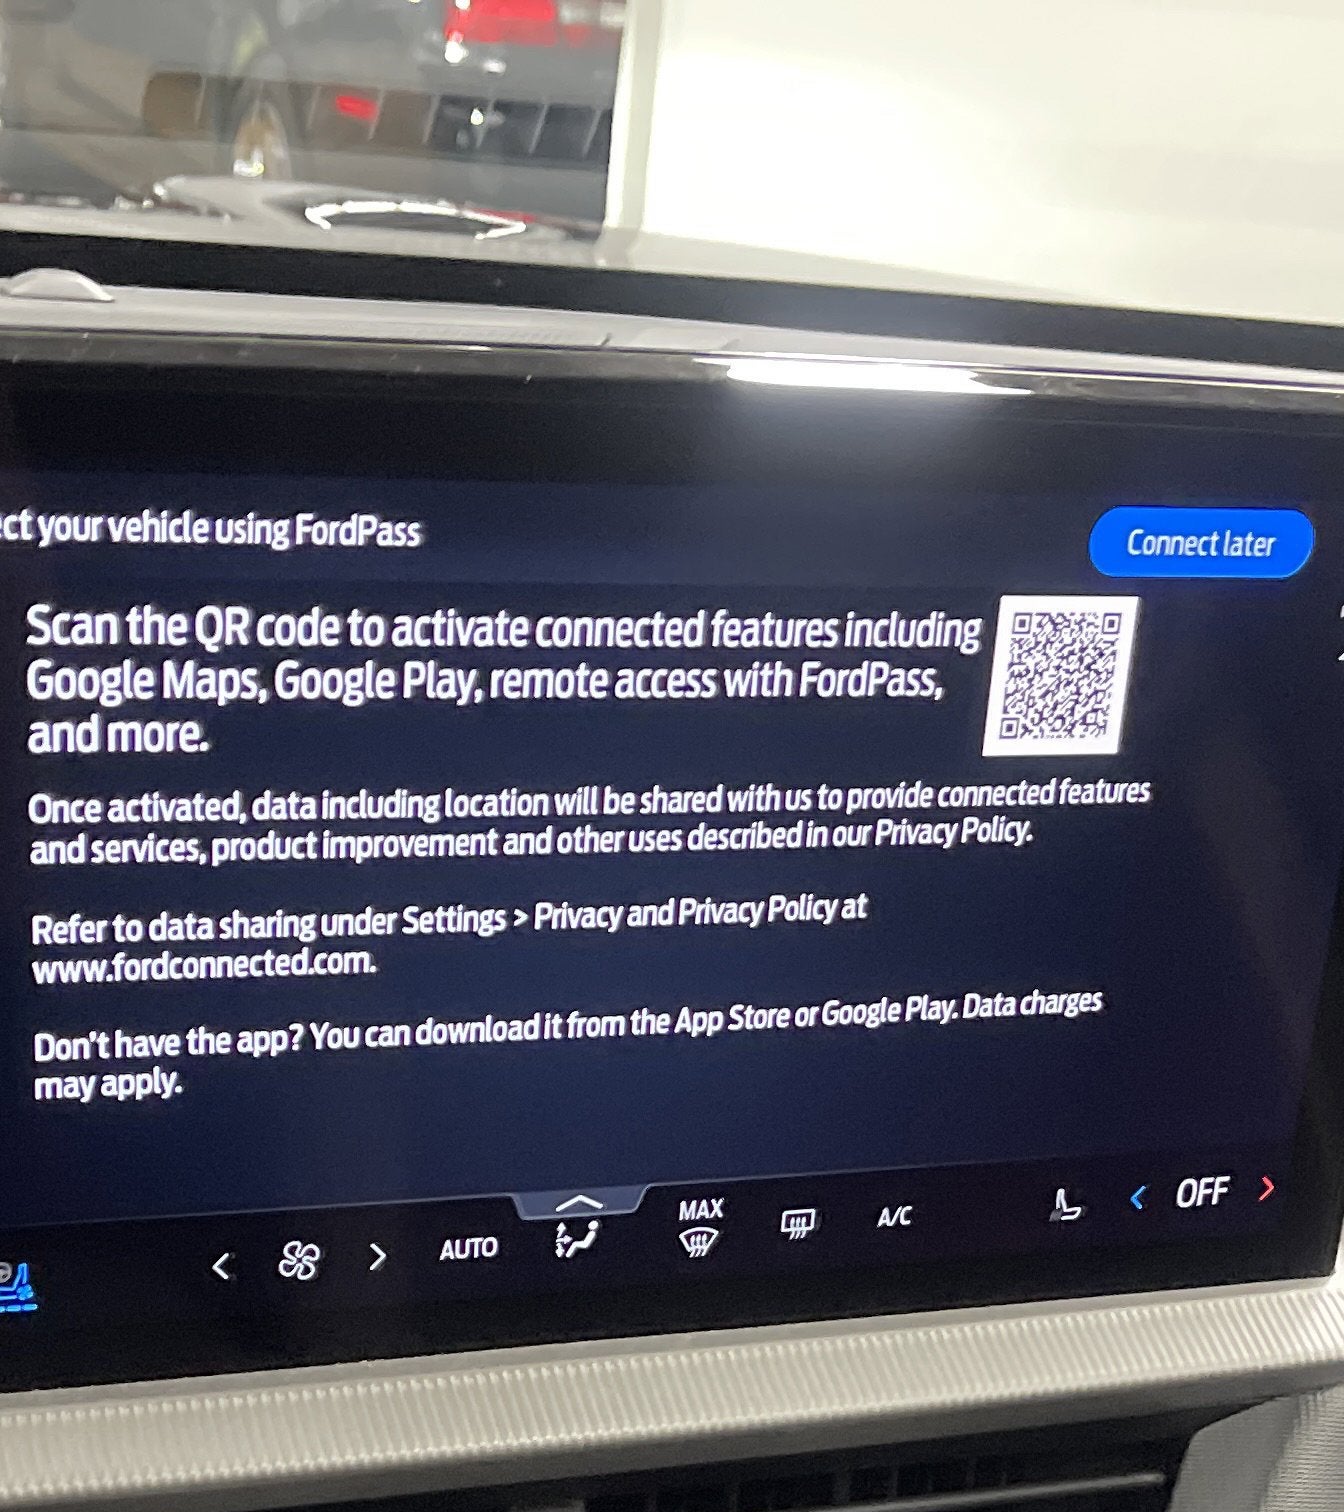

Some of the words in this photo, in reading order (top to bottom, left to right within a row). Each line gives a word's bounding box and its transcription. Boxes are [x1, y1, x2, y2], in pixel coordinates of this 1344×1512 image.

[36, 514, 104, 549] your
[107, 508, 212, 544] vehicle
[214, 511, 291, 552] using
[295, 512, 422, 548] FordPass
[1127, 529, 1221, 558] Connect
[1224, 531, 1276, 558] later
[26, 603, 121, 646] Scan
[124, 604, 193, 647] the
[194, 604, 253, 654] QR
[256, 605, 344, 647] code
[346, 608, 388, 648] to
[391, 607, 533, 648] activate
[535, 608, 709, 649] connected
[710, 608, 841, 649] features
[844, 610, 984, 656] including
[26, 657, 158, 708] Google
[162, 659, 270, 707] Maps,
[274, 658, 399, 708] Google
[402, 659, 486, 707] Play,
[489, 661, 612, 700] remote
[614, 667, 720, 700] access
[723, 660, 796, 698] with
[799, 659, 945, 701] FordPass,
[27, 711, 102, 754] and
[107, 719, 210, 754] more.
[27, 792, 105, 825] Once
[106, 789, 250, 825] activated,
[251, 789, 321, 821] data
[321, 787, 444, 824] including
[444, 787, 554, 818] location
[553, 785, 602, 816] will
[602, 785, 640, 816] be
[639, 783, 727, 815] shared
[726, 782, 785, 813] with
[784, 788, 814, 812] us
[816, 783, 846, 811] to
[845, 779, 937, 816] provide
[937, 777, 1059, 808] connected
[1058, 776, 1152, 805] features
[29, 832, 89, 865] and
[90, 832, 210, 866] services,
[211, 829, 319, 867] product
[322, 827, 501, 865] improvement
[502, 824, 556, 856] and
[556, 823, 628, 855] other
[628, 828, 685, 853] uses
[686, 819, 805, 851] described
[805, 819, 830, 848] in
[831, 824, 874, 848] our
[874, 817, 959, 849] Privacy
[960, 814, 1034, 847] Policy.
[31, 913, 109, 946] Refer
[111, 913, 145, 943] to
[148, 910, 216, 942] data
[218, 908, 318, 943] sharing
[320, 905, 399, 937] under
[401, 903, 508, 938] Settings
[534, 901, 625, 933] Privacy
[626, 897, 676, 928] and
[678, 896, 766, 929] Privacy
[767, 892, 839, 925] Policy
[840, 892, 869, 920] at
[31, 946, 378, 985] www.fordconnected.com.
[34, 1030, 111, 1063] Don't
[114, 1029, 182, 1059] have
[185, 1025, 233, 1056] the
[236, 1022, 306, 1058] app?
[309, 1021, 362, 1050] You
[364, 1024, 412, 1048] can
[415, 1011, 542, 1046] download
[543, 1012, 564, 1040] it
[565, 1010, 628, 1039] from
[629, 1007, 672, 1036] the
[673, 1006, 725, 1038] App
[727, 1003, 792, 1031] Store
[794, 1005, 820, 1028] or
[821, 996, 903, 1029] Google
[904, 993, 959, 1025] Play.
[962, 992, 1017, 1019] Data
[1019, 988, 1103, 1018] charges
[34, 1074, 97, 1104] may
[100, 1065, 183, 1102] apply.
[678, 1198, 725, 1222] MAX
[1175, 1176, 1230, 1209] OFF
[877, 1205, 913, 1228] A/C
[439, 1236, 498, 1262] AUTO
